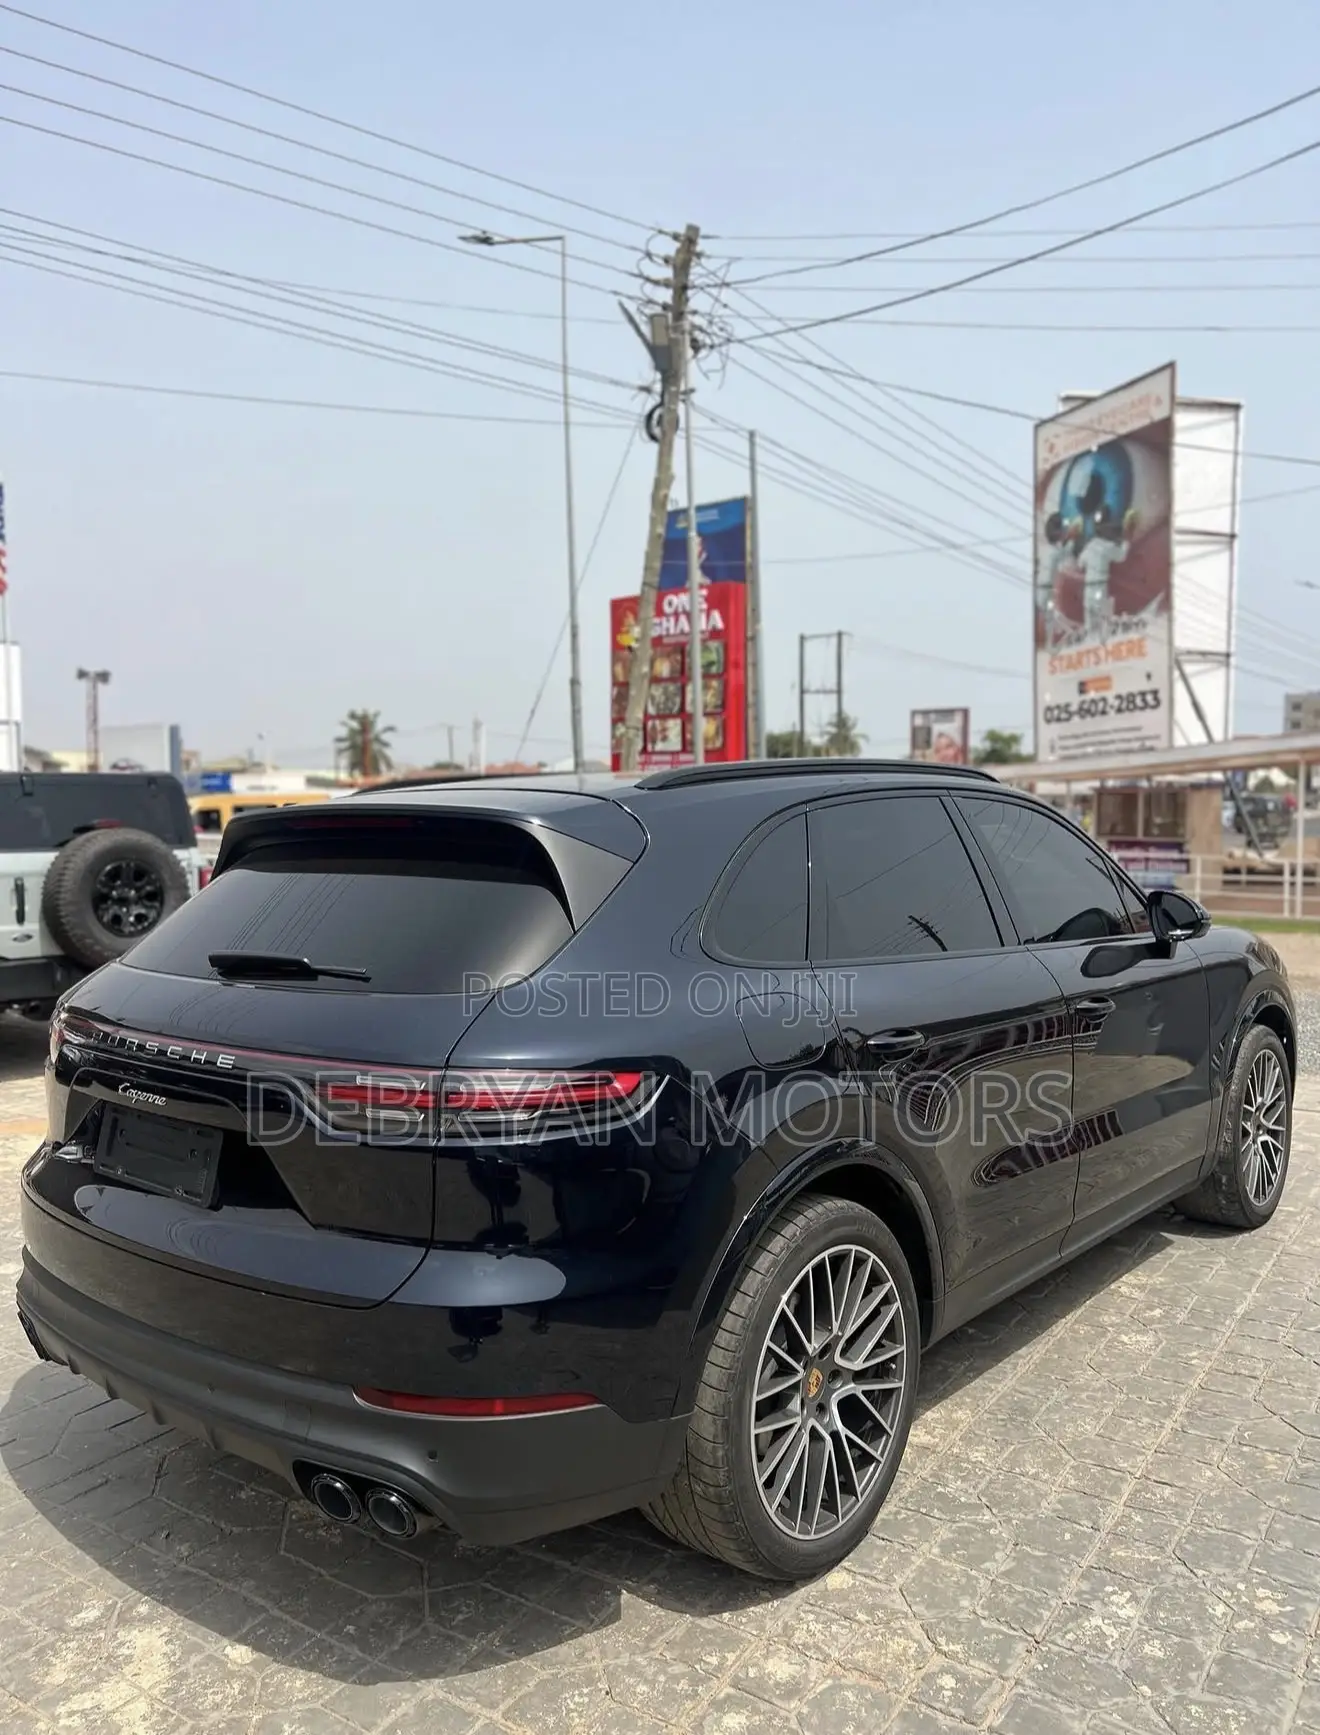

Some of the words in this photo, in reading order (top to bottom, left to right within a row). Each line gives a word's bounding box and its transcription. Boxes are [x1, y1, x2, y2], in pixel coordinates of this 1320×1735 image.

[1048, 645, 1106, 676] STARTS
[1106, 636, 1148, 663] HERE
[1044, 689, 1161, 723] 025-602-2833
[118, 1082, 168, 1107] Cayenne
